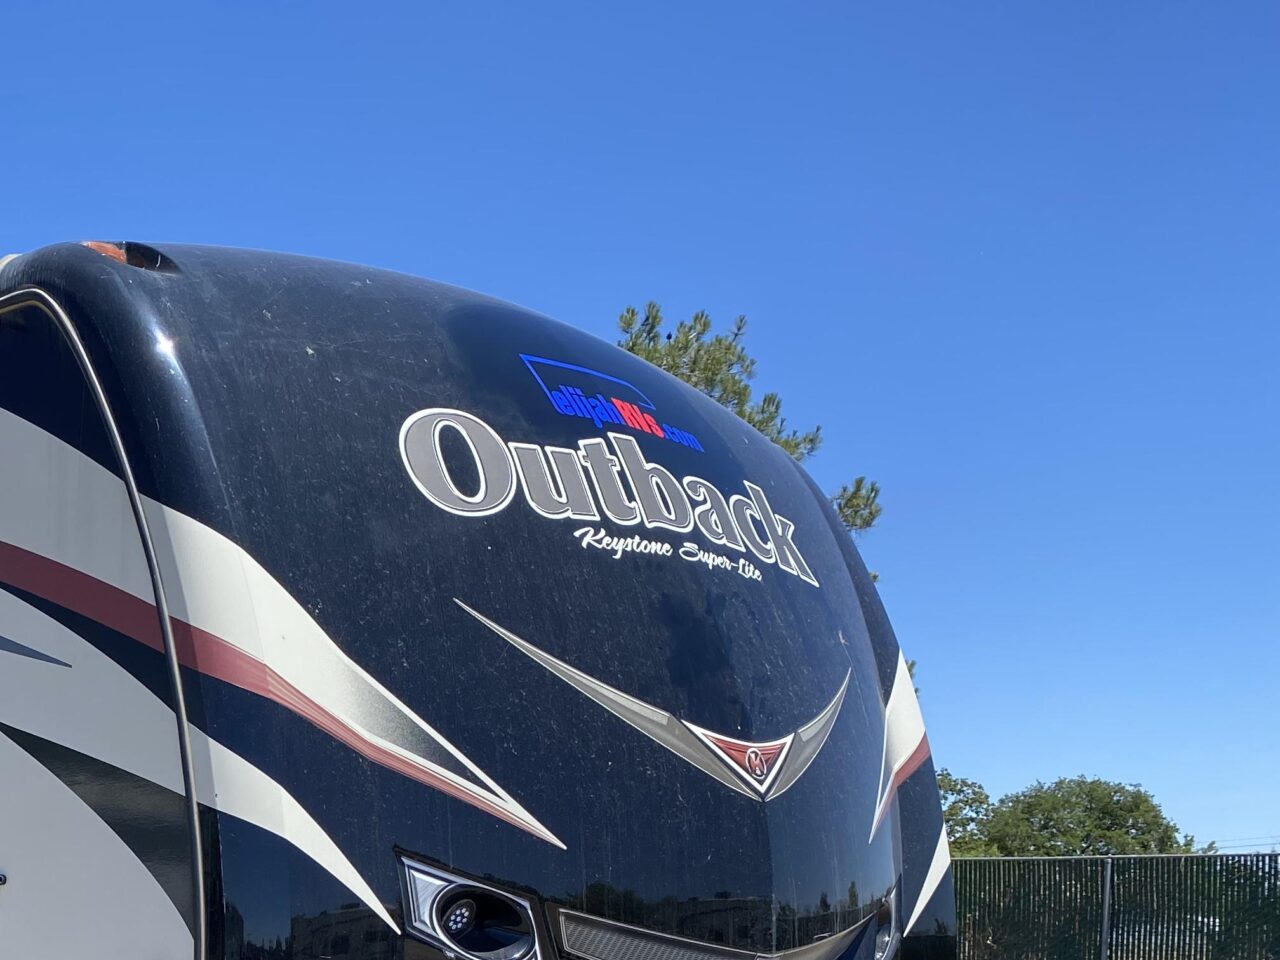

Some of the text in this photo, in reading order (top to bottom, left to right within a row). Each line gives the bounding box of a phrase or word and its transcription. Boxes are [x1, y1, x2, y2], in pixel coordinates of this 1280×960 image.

[399, 408, 819, 587] Outback
[573, 527, 762, 582] Keystone Super-Lite
